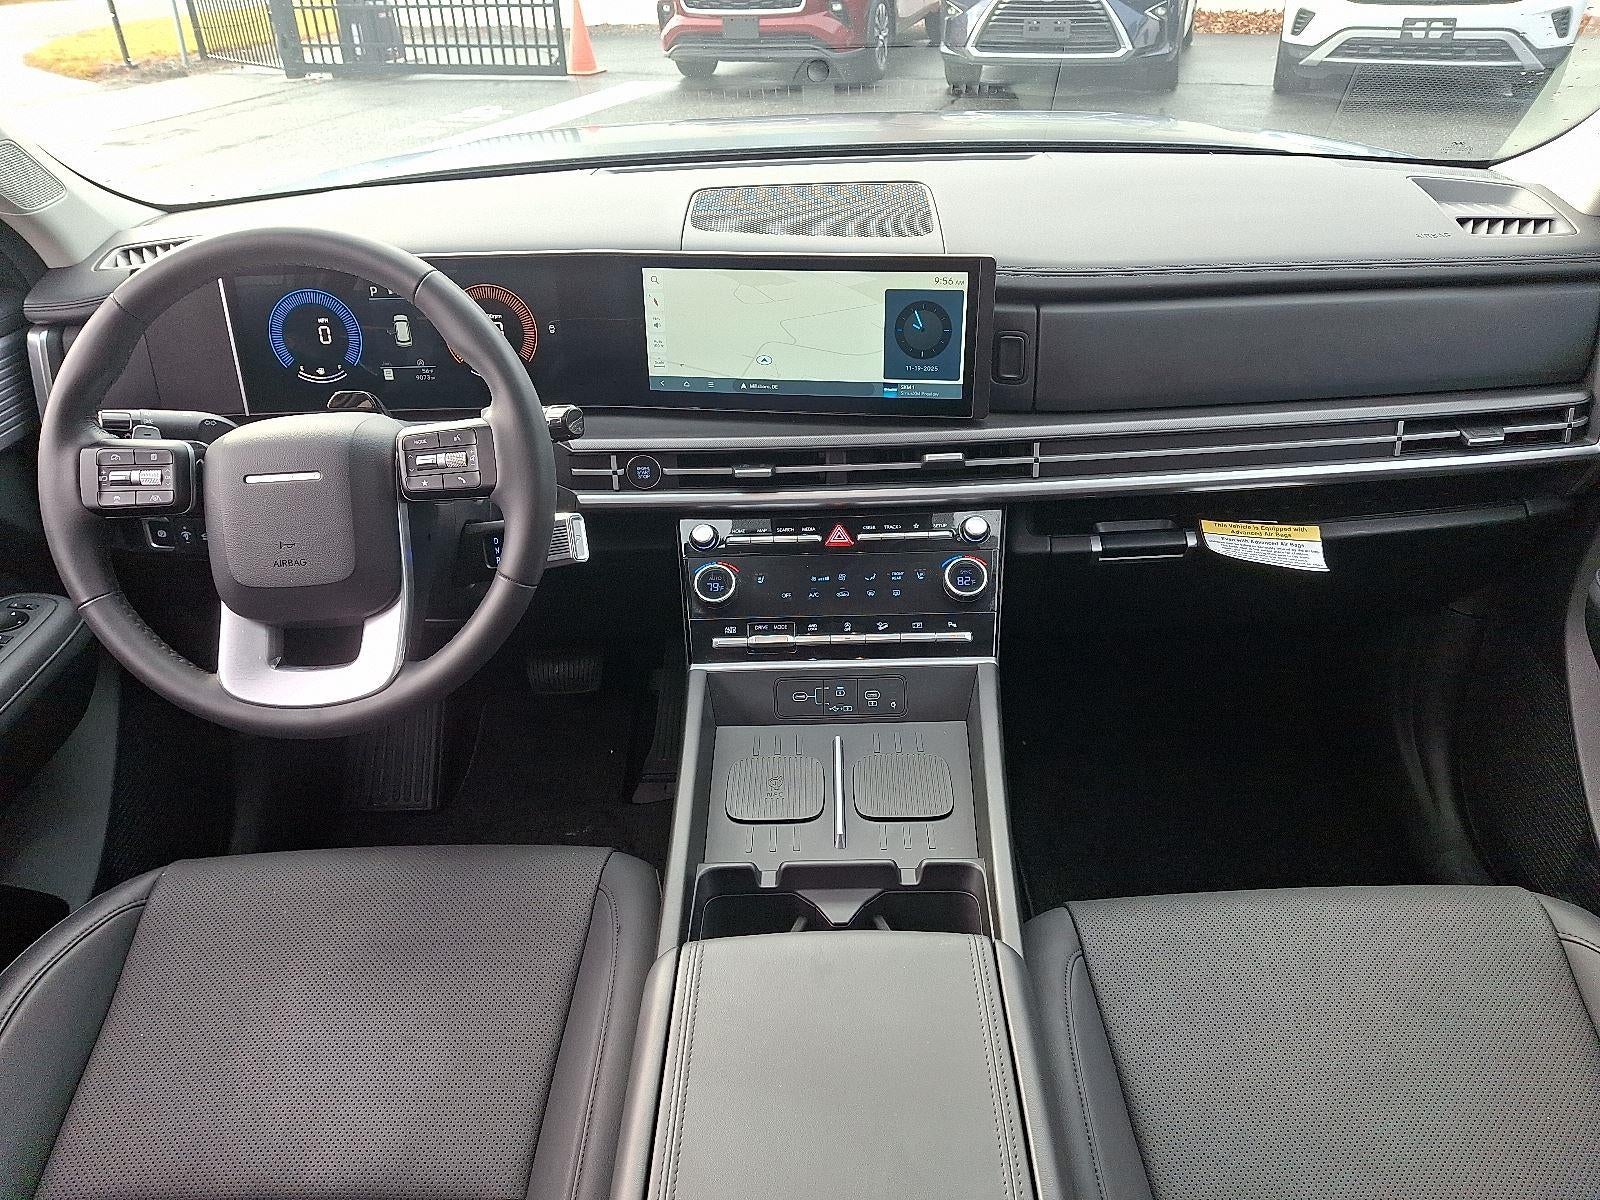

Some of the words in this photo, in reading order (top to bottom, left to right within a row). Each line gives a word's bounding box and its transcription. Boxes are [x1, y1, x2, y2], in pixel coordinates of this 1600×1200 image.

[934, 277, 954, 286] 9:56
[370, 286, 378, 297] P
[318, 325, 332, 345] 0
[905, 365, 939, 373] 11-19-2025
[1260, 525, 1292, 533] Equipped
[273, 558, 307, 568] AIRBAG
